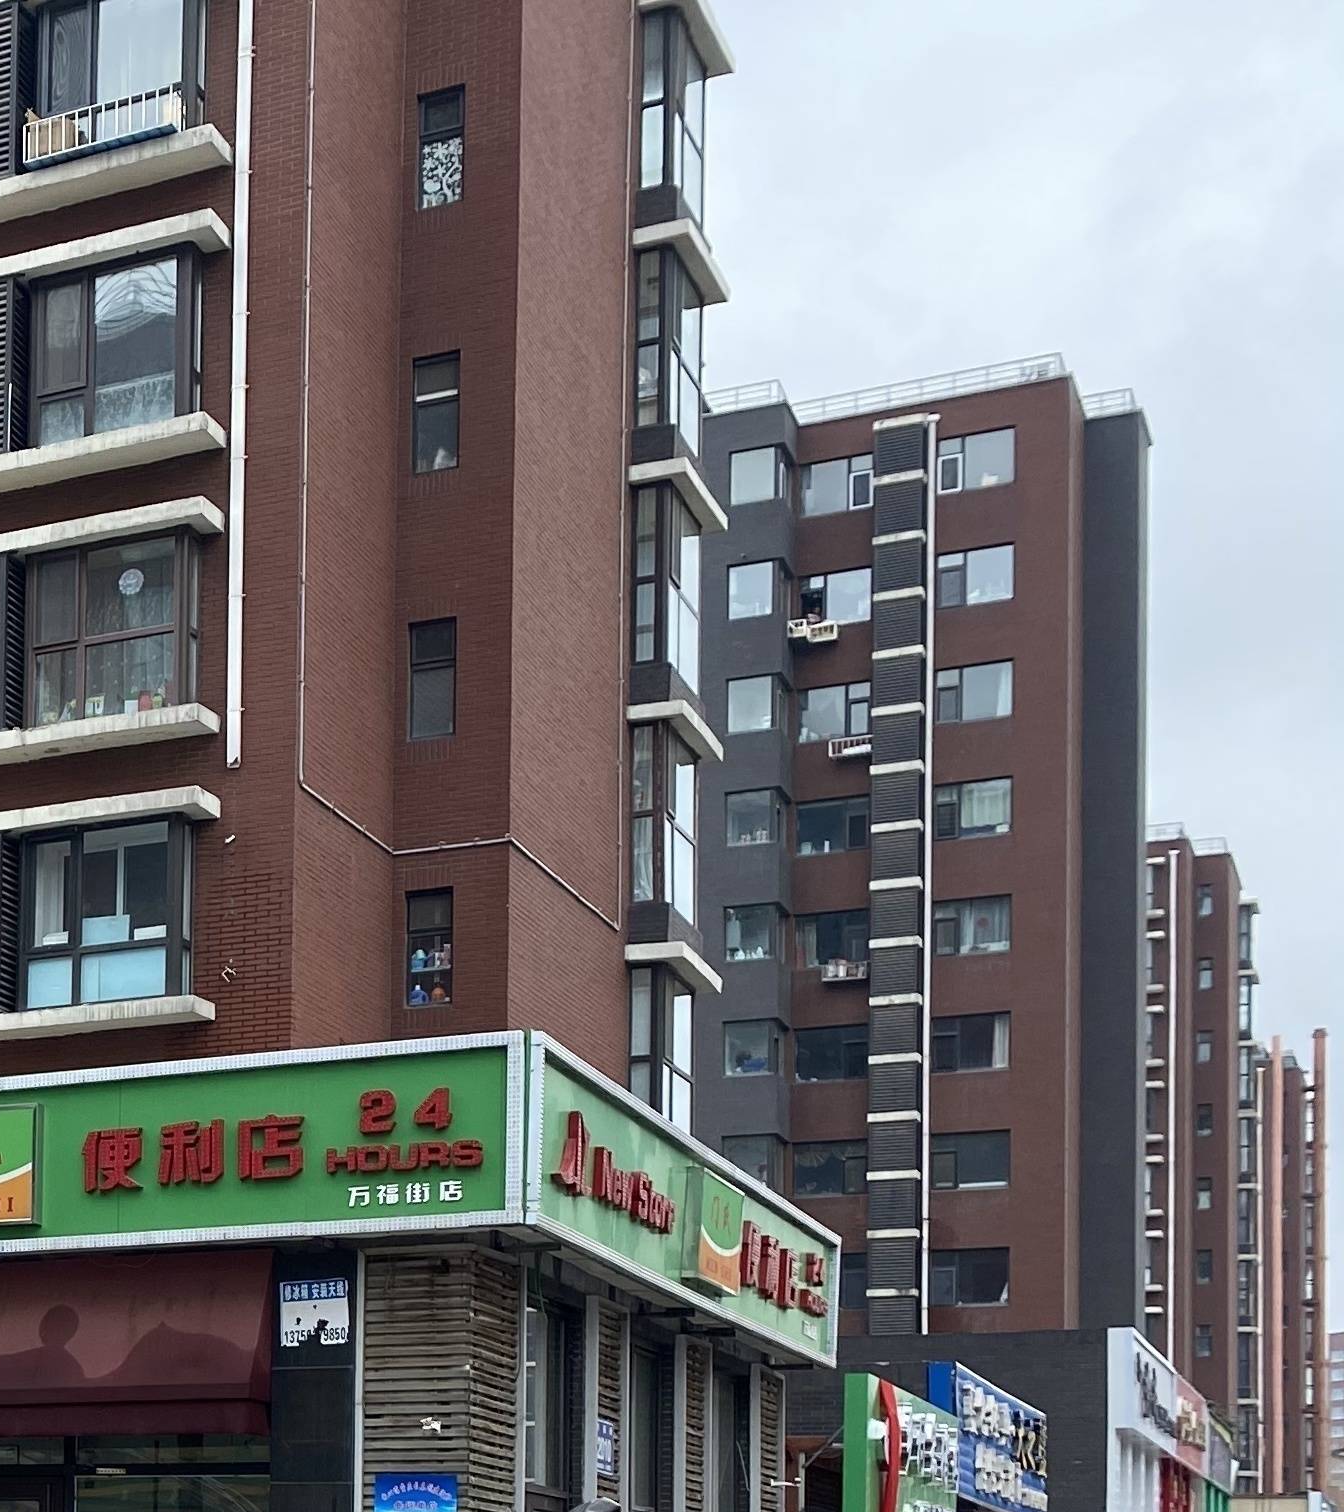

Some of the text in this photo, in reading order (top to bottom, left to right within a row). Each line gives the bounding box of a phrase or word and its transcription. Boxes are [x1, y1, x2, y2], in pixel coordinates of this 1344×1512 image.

[359, 1087, 452, 1134] 24
[82, 1114, 305, 1193] 便利店
[326, 1140, 483, 1174] HOURS
[348, 1180, 463, 1207] 万福街店
